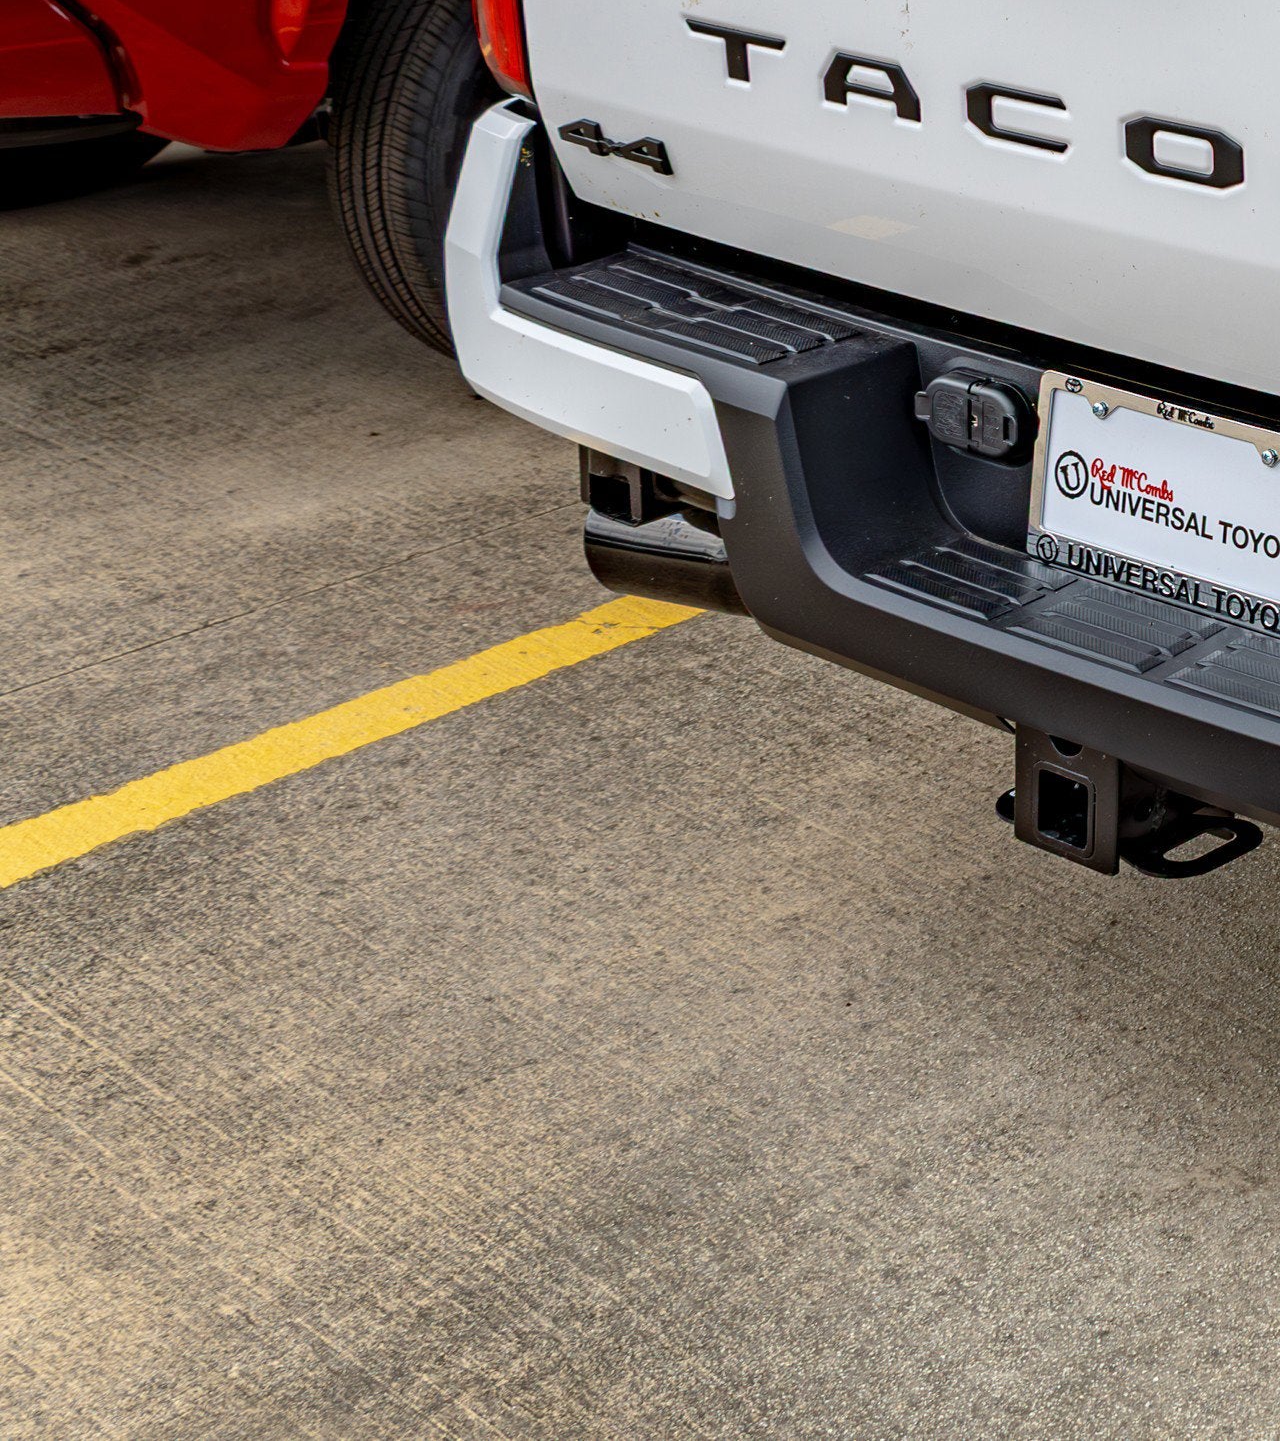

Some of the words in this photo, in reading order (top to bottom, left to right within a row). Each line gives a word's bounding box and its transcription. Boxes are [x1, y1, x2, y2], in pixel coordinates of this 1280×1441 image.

[1091, 458, 1115, 489] Red
[1118, 465, 1174, 502] McCombs
[1089, 482, 1214, 540] UNIVERSAL
[1067, 542, 1208, 607] UNIVERSAL
